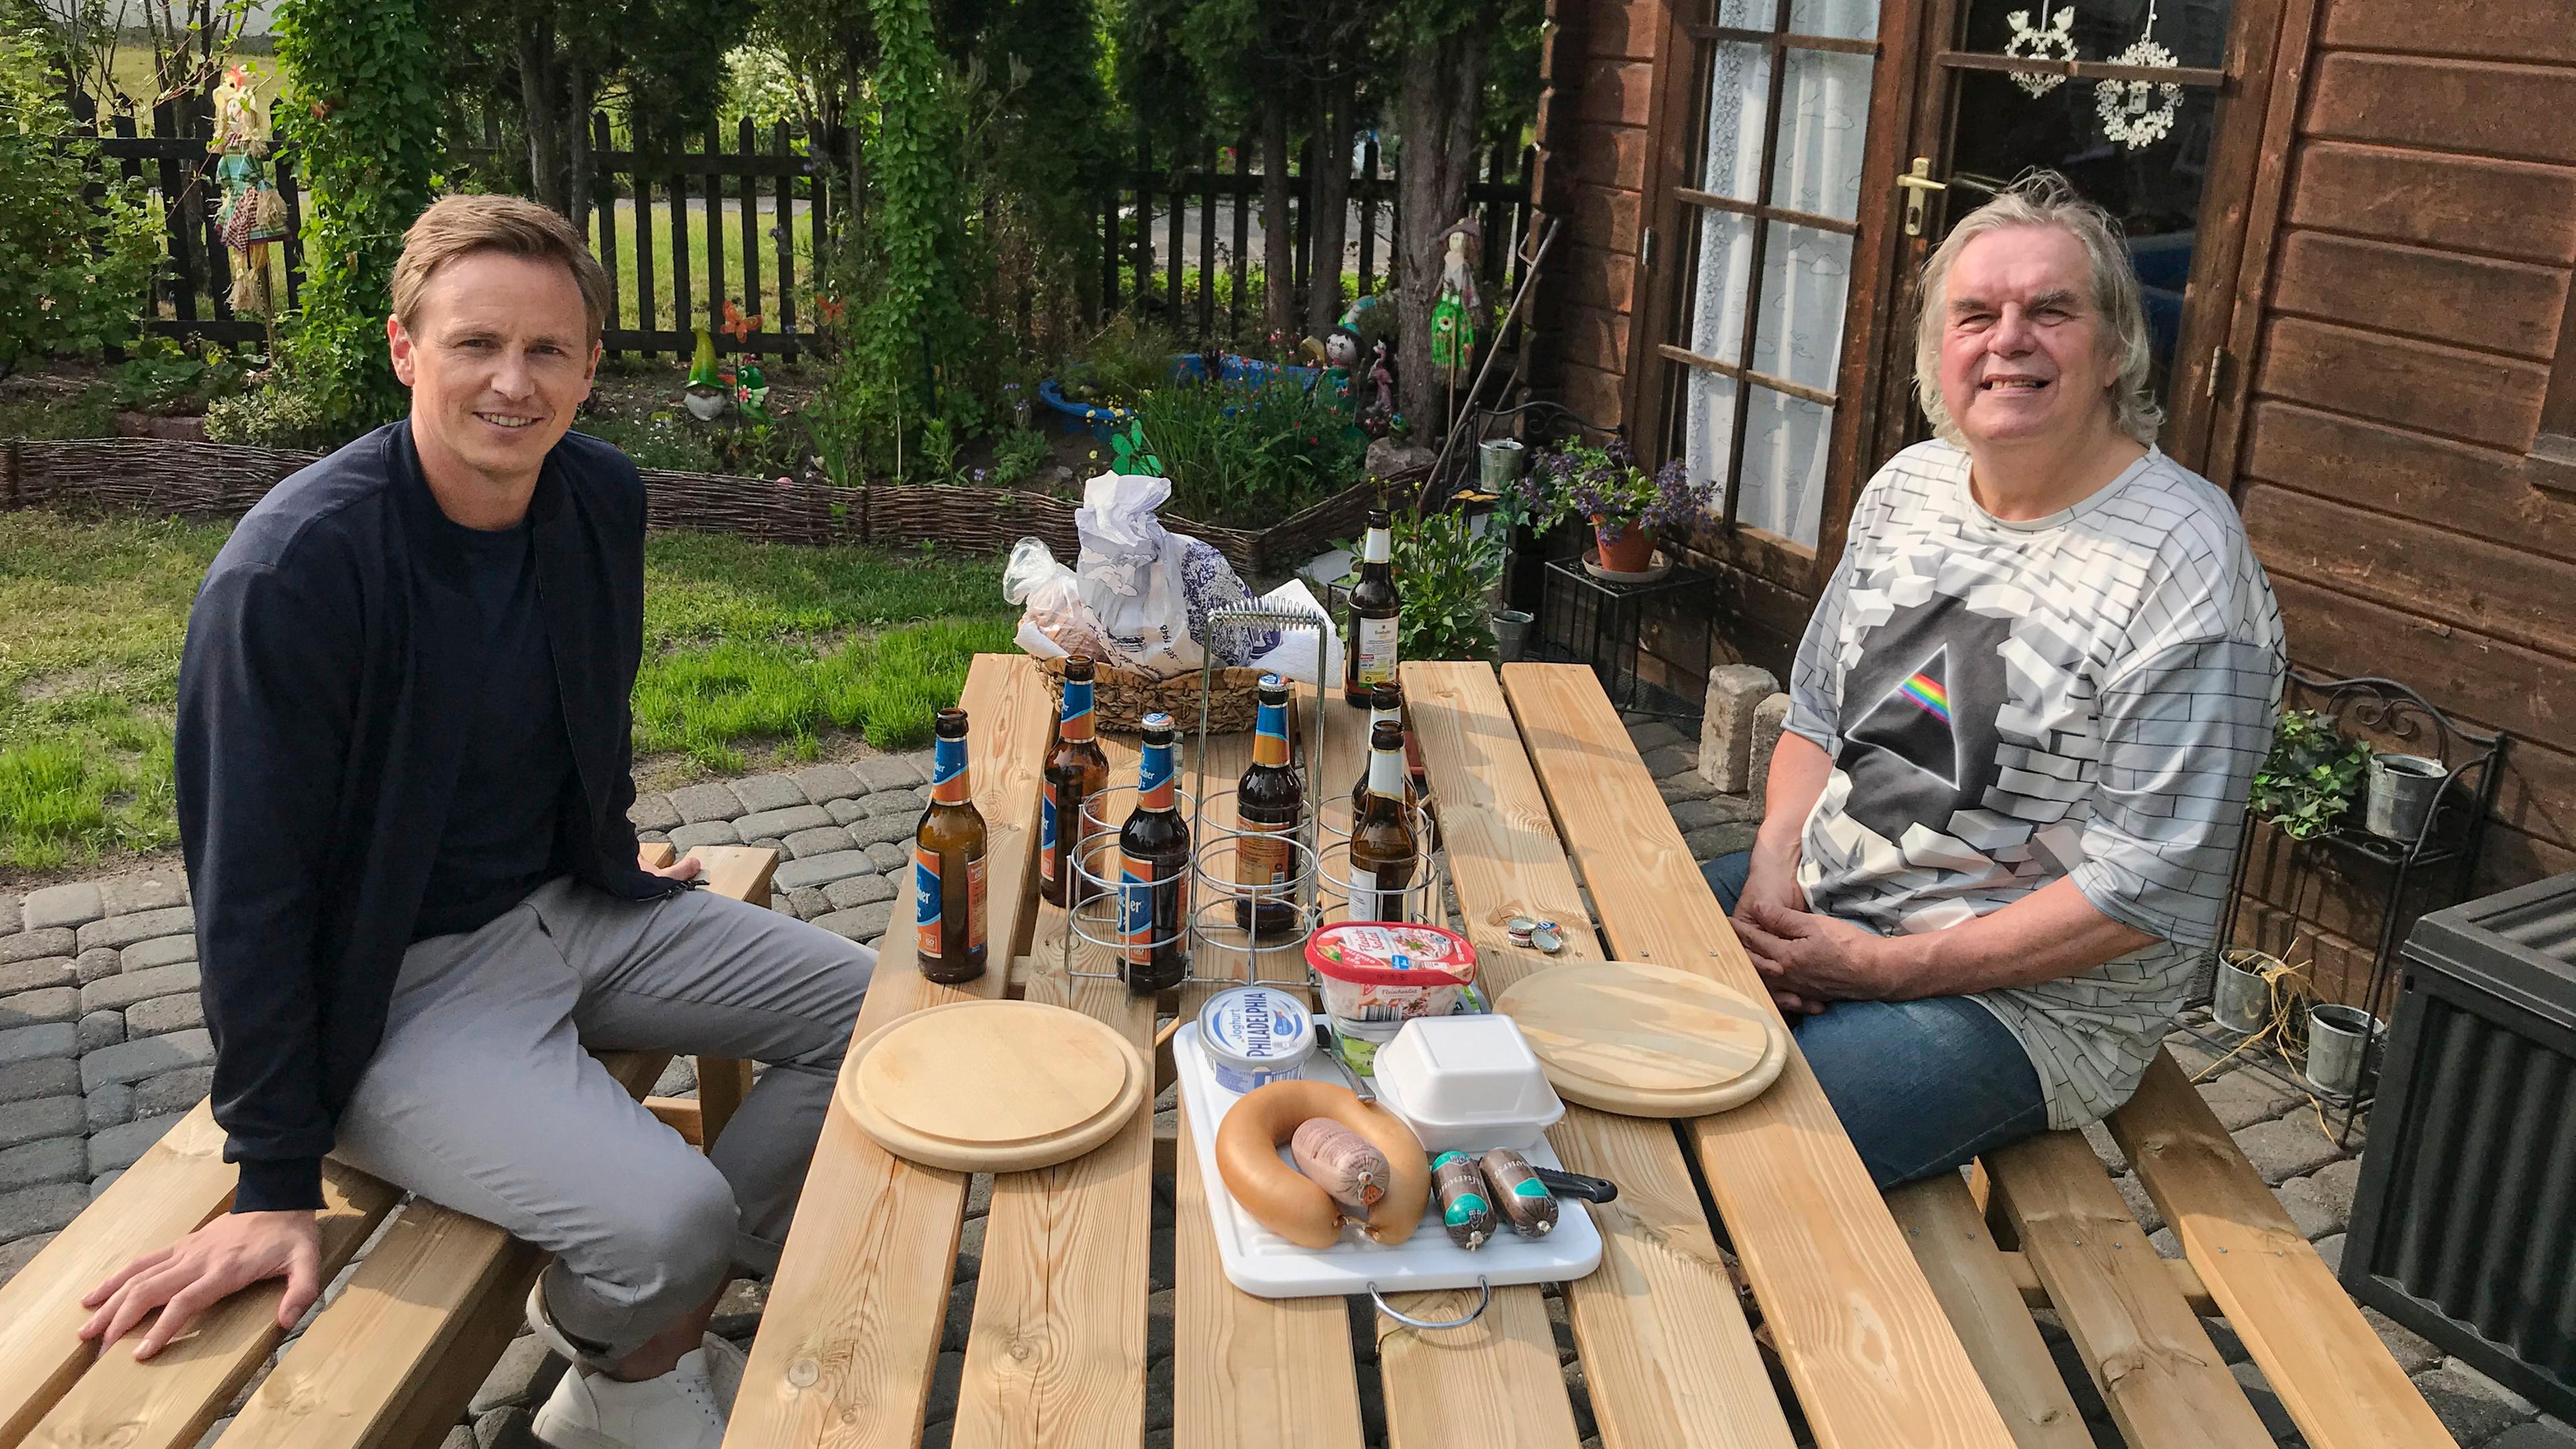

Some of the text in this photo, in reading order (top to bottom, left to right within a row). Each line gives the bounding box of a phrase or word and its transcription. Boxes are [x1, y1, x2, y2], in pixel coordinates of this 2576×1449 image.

[1159, 625, 1173, 643] 1948
[1228, 1008, 1245, 1039] Joghurt
[1244, 992, 1274, 1057] PHILADELPHIA
